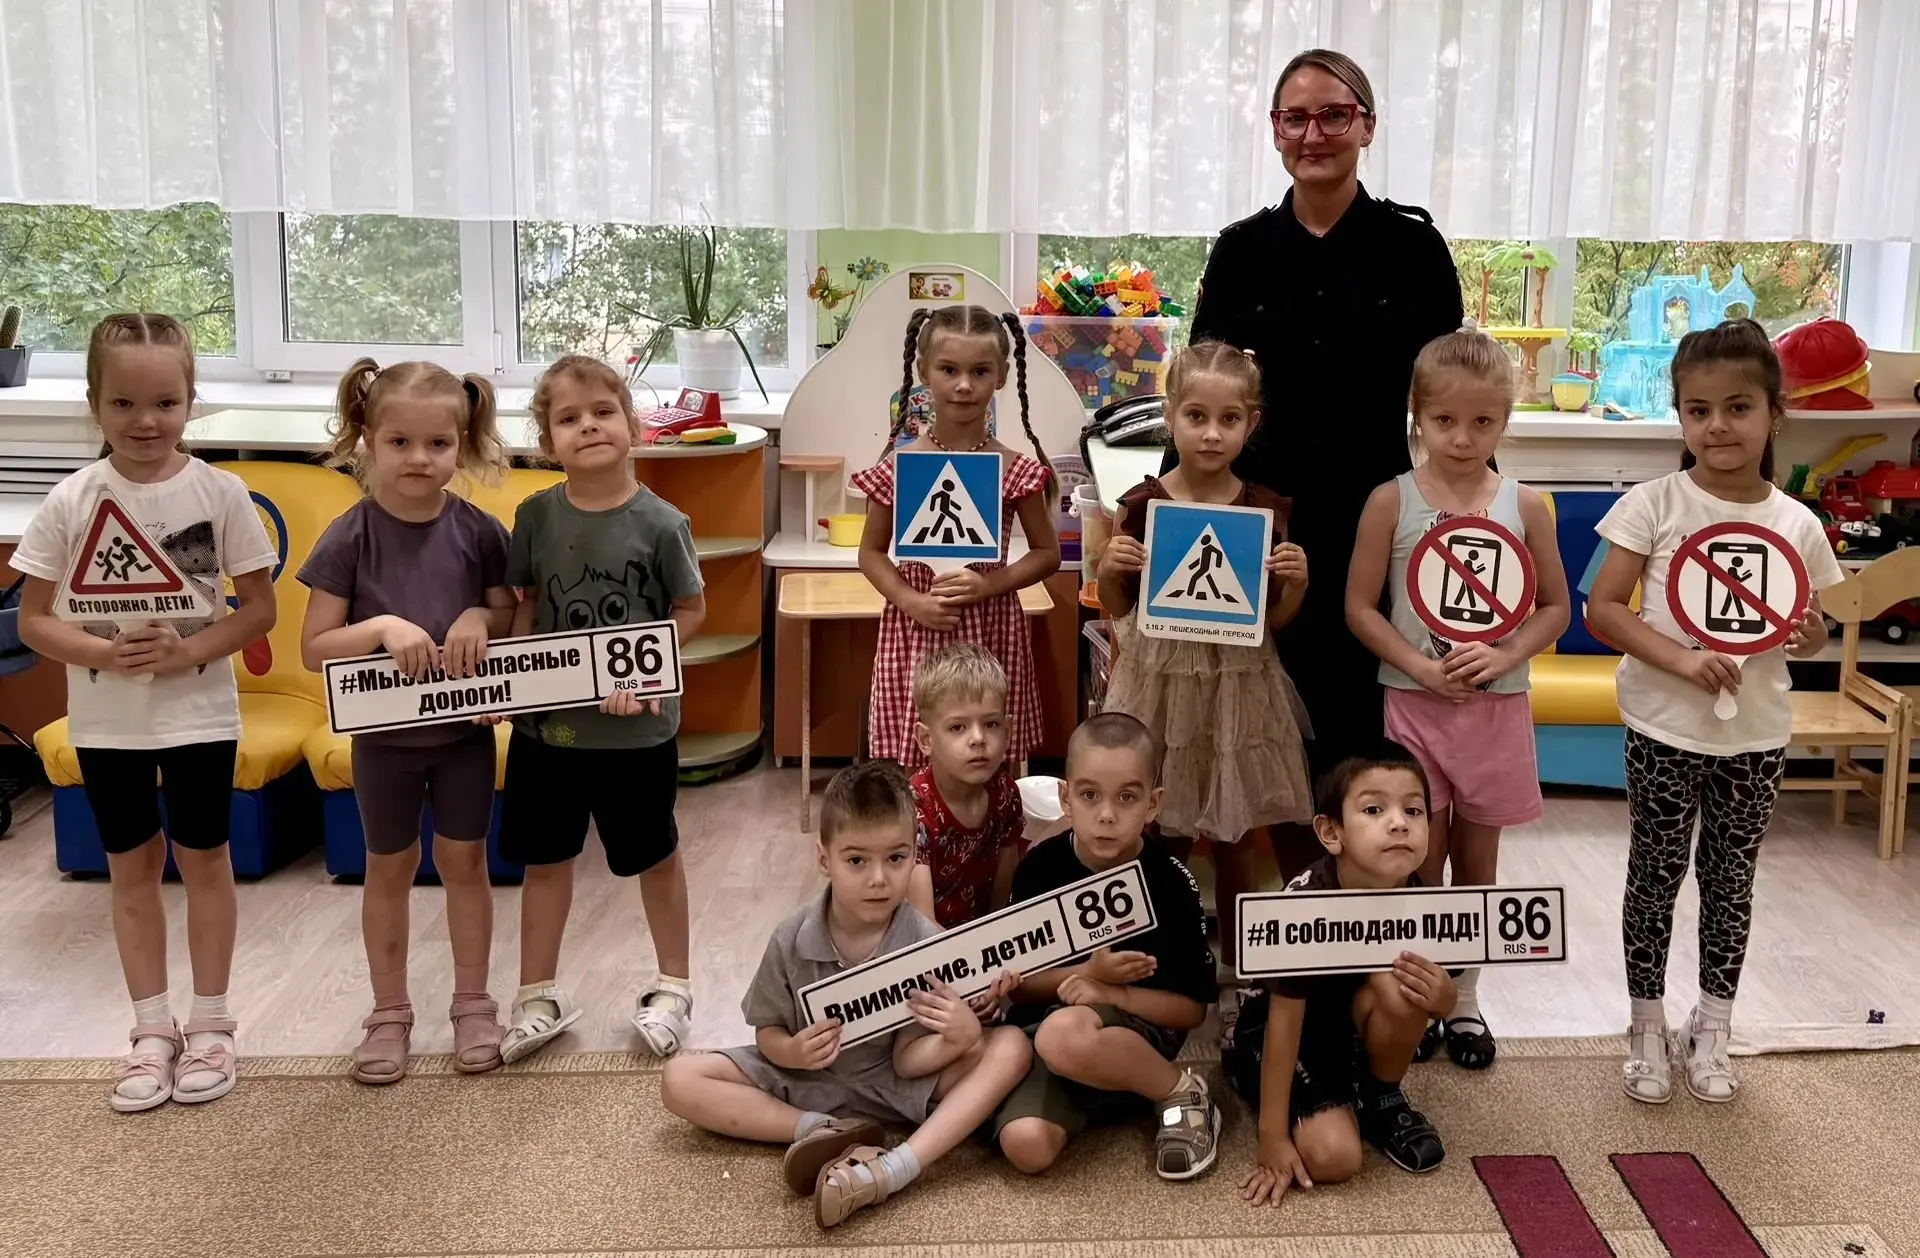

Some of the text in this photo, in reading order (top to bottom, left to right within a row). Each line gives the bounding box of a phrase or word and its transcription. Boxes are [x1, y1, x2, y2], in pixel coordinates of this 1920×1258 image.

[69, 595, 195, 614] Осторожно, ДЕТИ!
[1169, 624, 1220, 636] ПЕШЕХОДНЫЙ
[1222, 630, 1256, 639] ПЕРЕХОД
[606, 634, 663, 679] 86
[419, 680, 512, 715] дороги!
[614, 679, 638, 690] RUS
[1074, 879, 1135, 930] 86
[1498, 896, 1551, 941] 86
[1089, 925, 1113, 942] RUS
[1247, 912, 1480, 947] #Я соблюдаю ПДД!
[1504, 944, 1527, 955] RUS
[824, 920, 1056, 1027] Внимание, дети!
